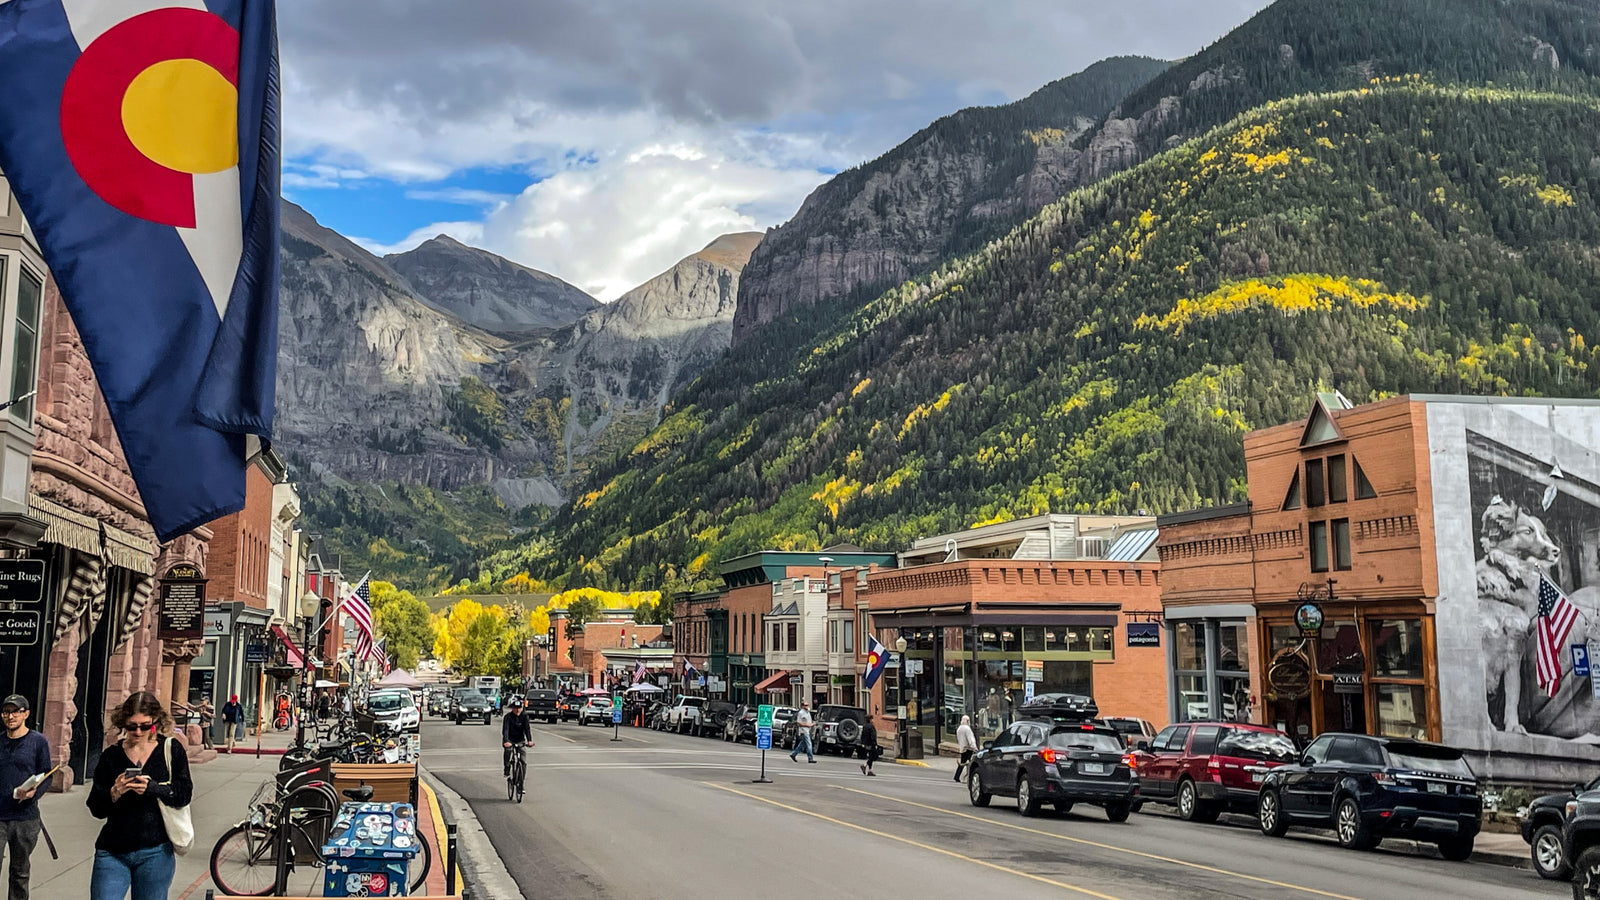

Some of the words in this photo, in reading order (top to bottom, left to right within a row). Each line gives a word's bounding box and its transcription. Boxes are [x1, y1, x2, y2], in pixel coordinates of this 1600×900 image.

[0, 571, 15, 580] ine
[18, 571, 41, 582] Rugs
[6, 619, 36, 628] Goods
[1573, 648, 1584, 665] P
